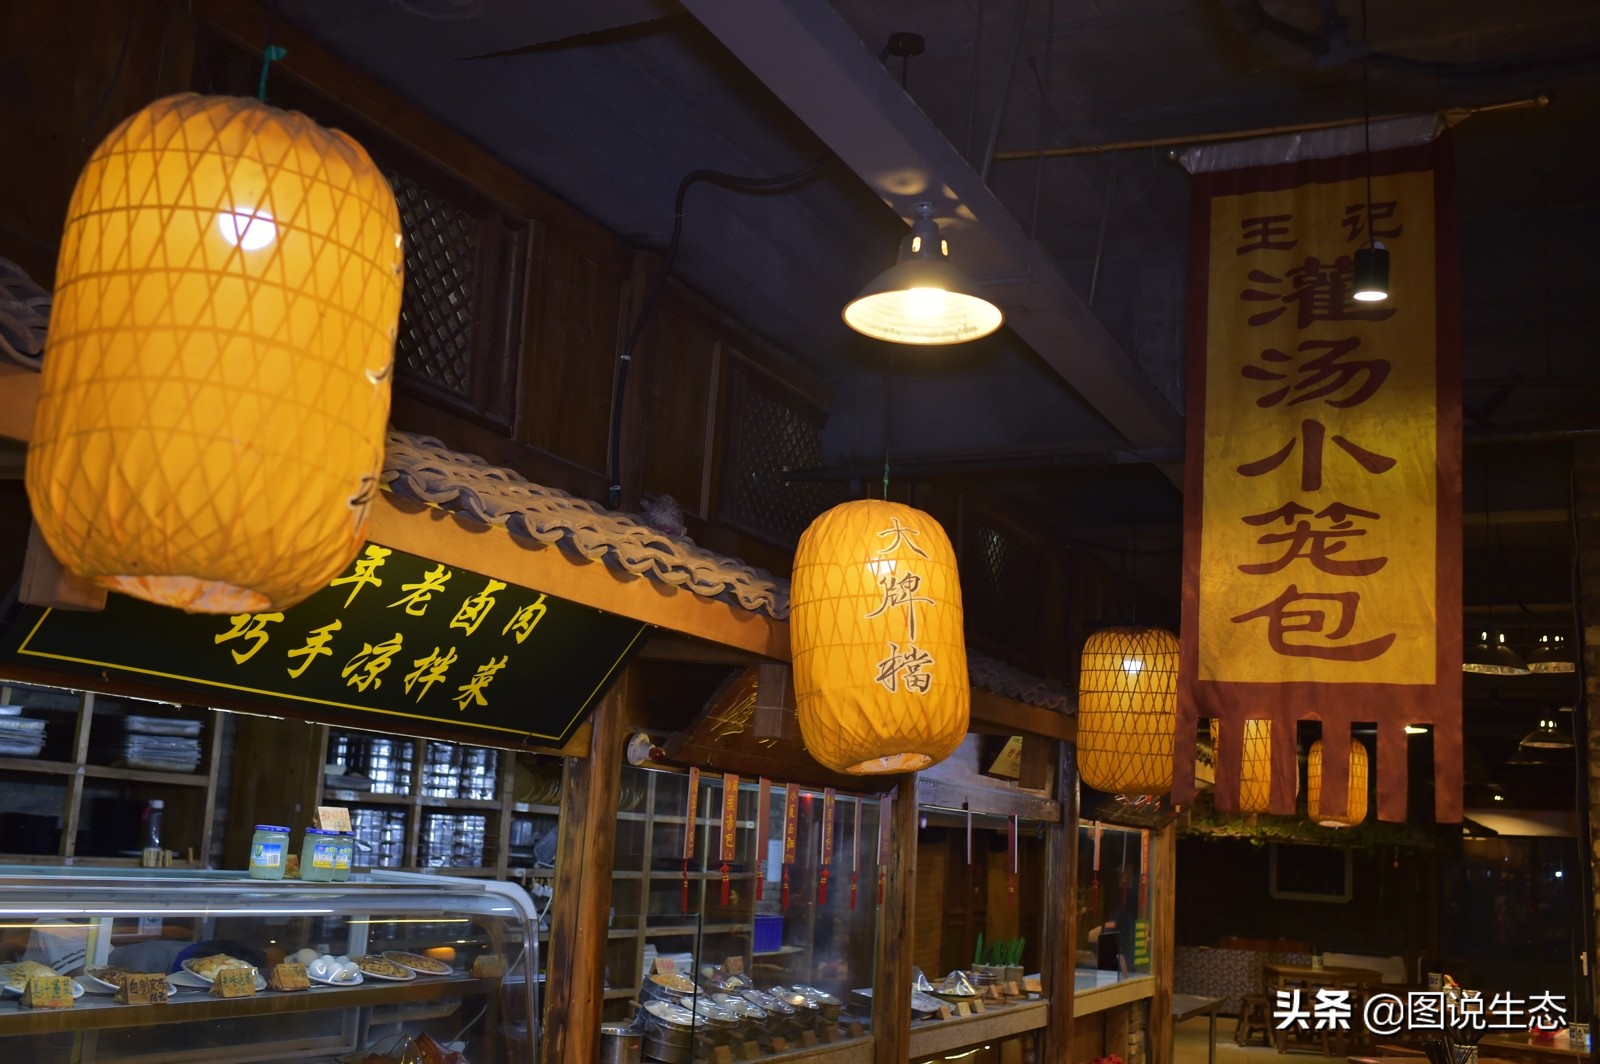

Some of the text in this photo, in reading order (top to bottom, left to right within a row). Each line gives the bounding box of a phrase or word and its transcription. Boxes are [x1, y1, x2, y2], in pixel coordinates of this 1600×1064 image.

[1236, 201, 1404, 256] 王记
[1230, 255, 1399, 662] 灌汤小笼包
